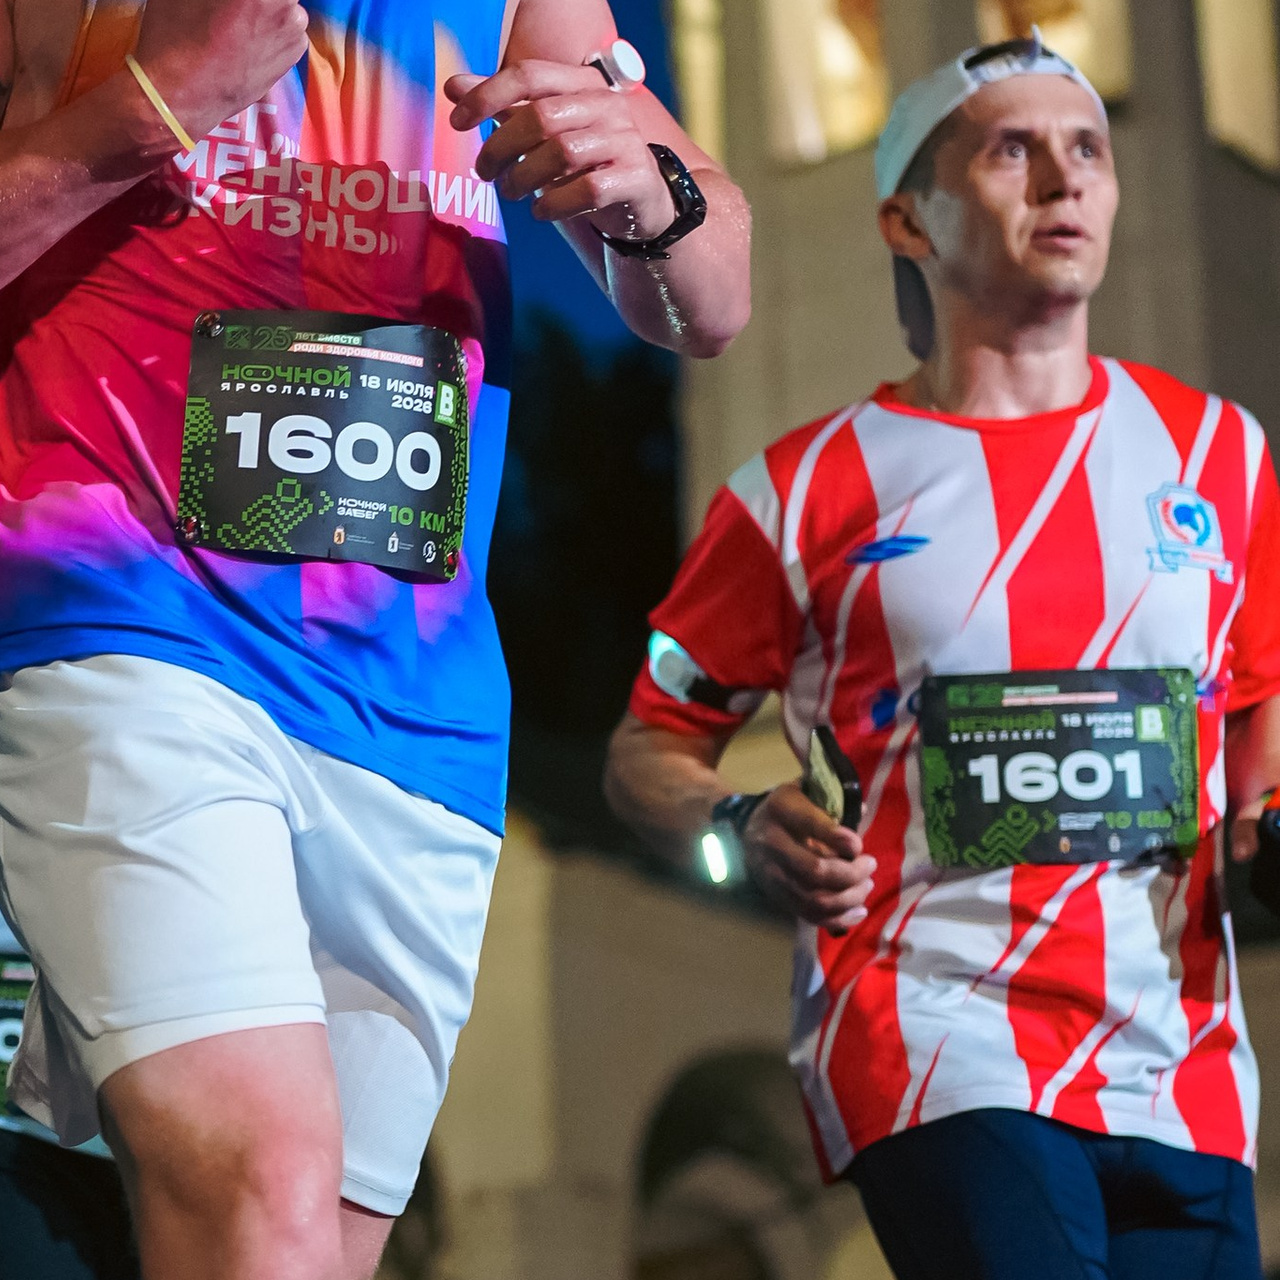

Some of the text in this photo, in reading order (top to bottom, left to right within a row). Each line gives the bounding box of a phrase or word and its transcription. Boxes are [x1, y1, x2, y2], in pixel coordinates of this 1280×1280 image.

[252, 326, 292, 351] 25
[317, 335, 360, 345] вместе
[294, 343, 423, 366] ради здоровья каждого
[221, 363, 351, 388] НОЧНОЙ
[359, 374, 434, 399] 18 ИЮЛЯ
[221, 383, 349, 400] ЯРОСЛАВЛЬ
[226, 411, 441, 491] 1600
[337, 507, 379, 520] ЗАБЕГ
[338, 497, 387, 512] НОЧНОЙ
[389, 505, 445, 533] 10 КМ
[968, 750, 1143, 803] 1601
